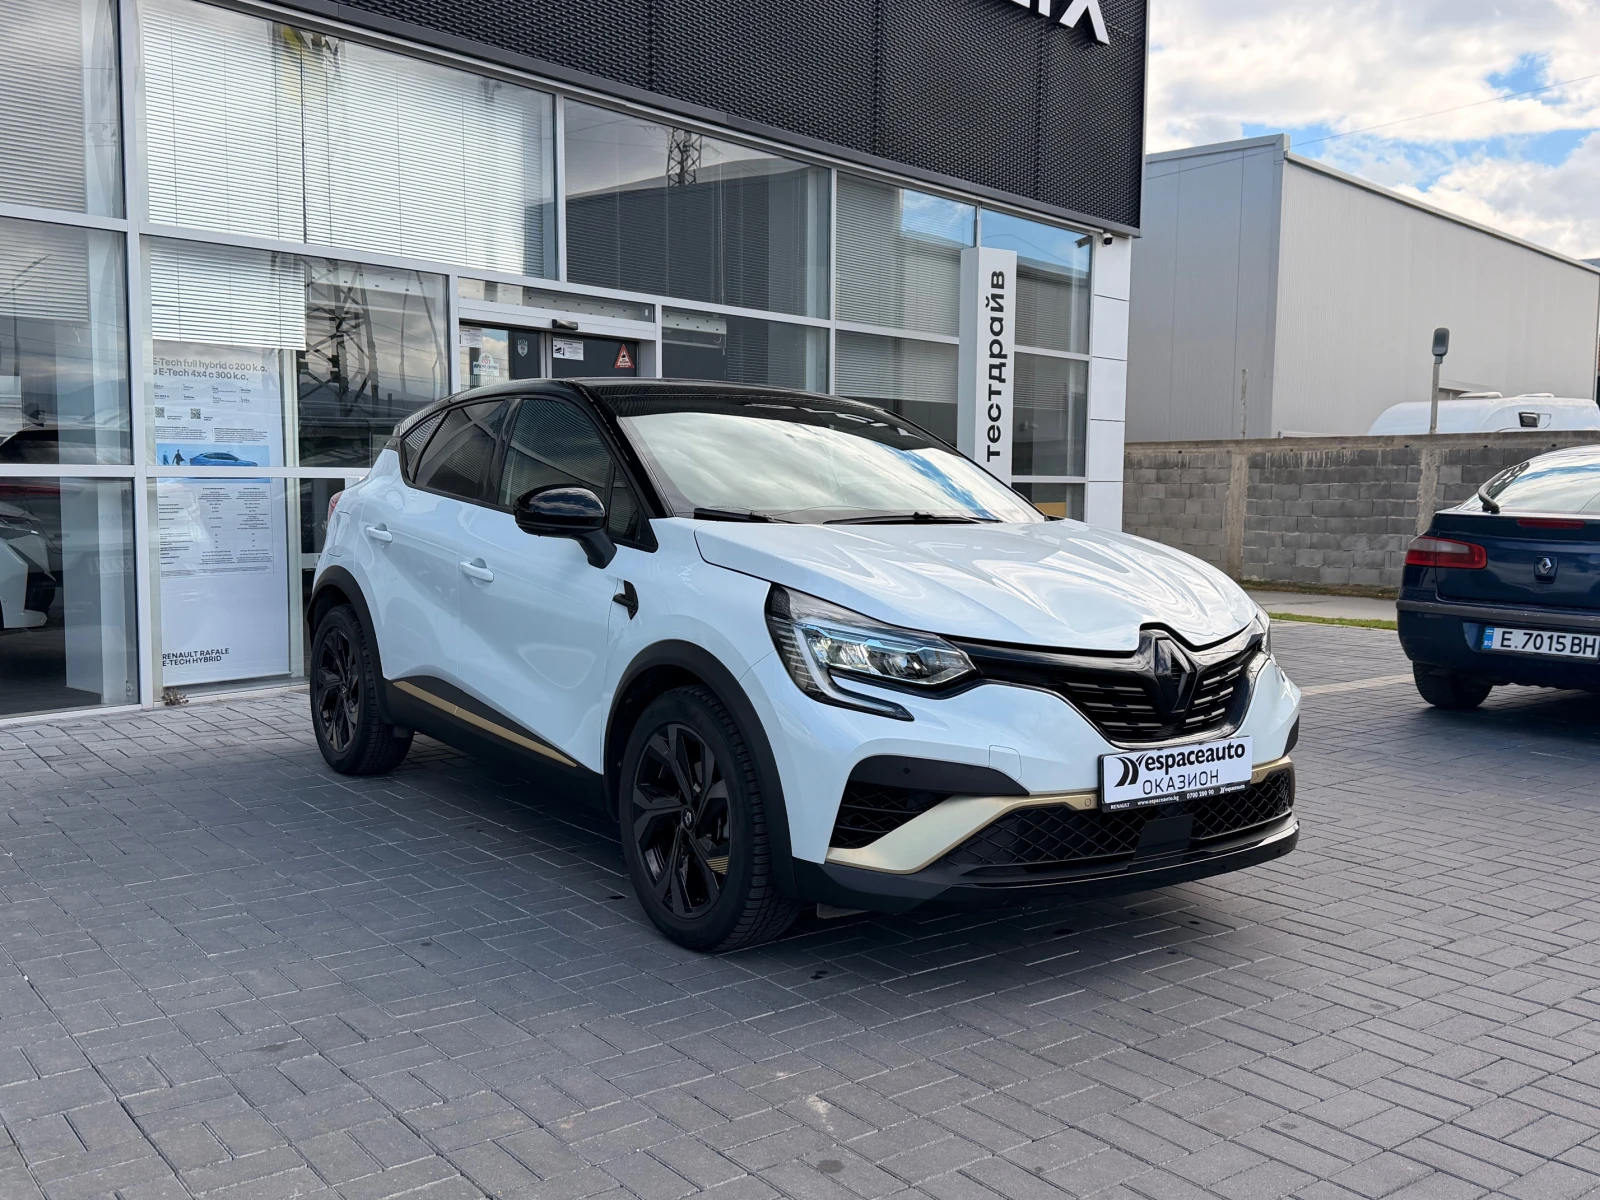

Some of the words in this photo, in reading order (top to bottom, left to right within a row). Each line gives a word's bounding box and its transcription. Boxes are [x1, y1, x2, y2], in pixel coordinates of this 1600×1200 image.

[183, 359, 198, 368] full
[199, 360, 227, 370] hybrid
[235, 363, 252, 371] 200
[986, 270, 1008, 462] тестдрайв
[158, 368, 190, 377] E-Tech
[191, 369, 208, 378] 4x4
[215, 371, 232, 379] 300
[162, 650, 198, 660] RENAULT
[199, 647, 230, 656] RAFALE
[162, 658, 191, 667] E-TECH
[192, 655, 222, 664] HYBRID
[1144, 741, 1246, 775] espaceauto
[1142, 769, 1219, 795] ОКАЗИОН
